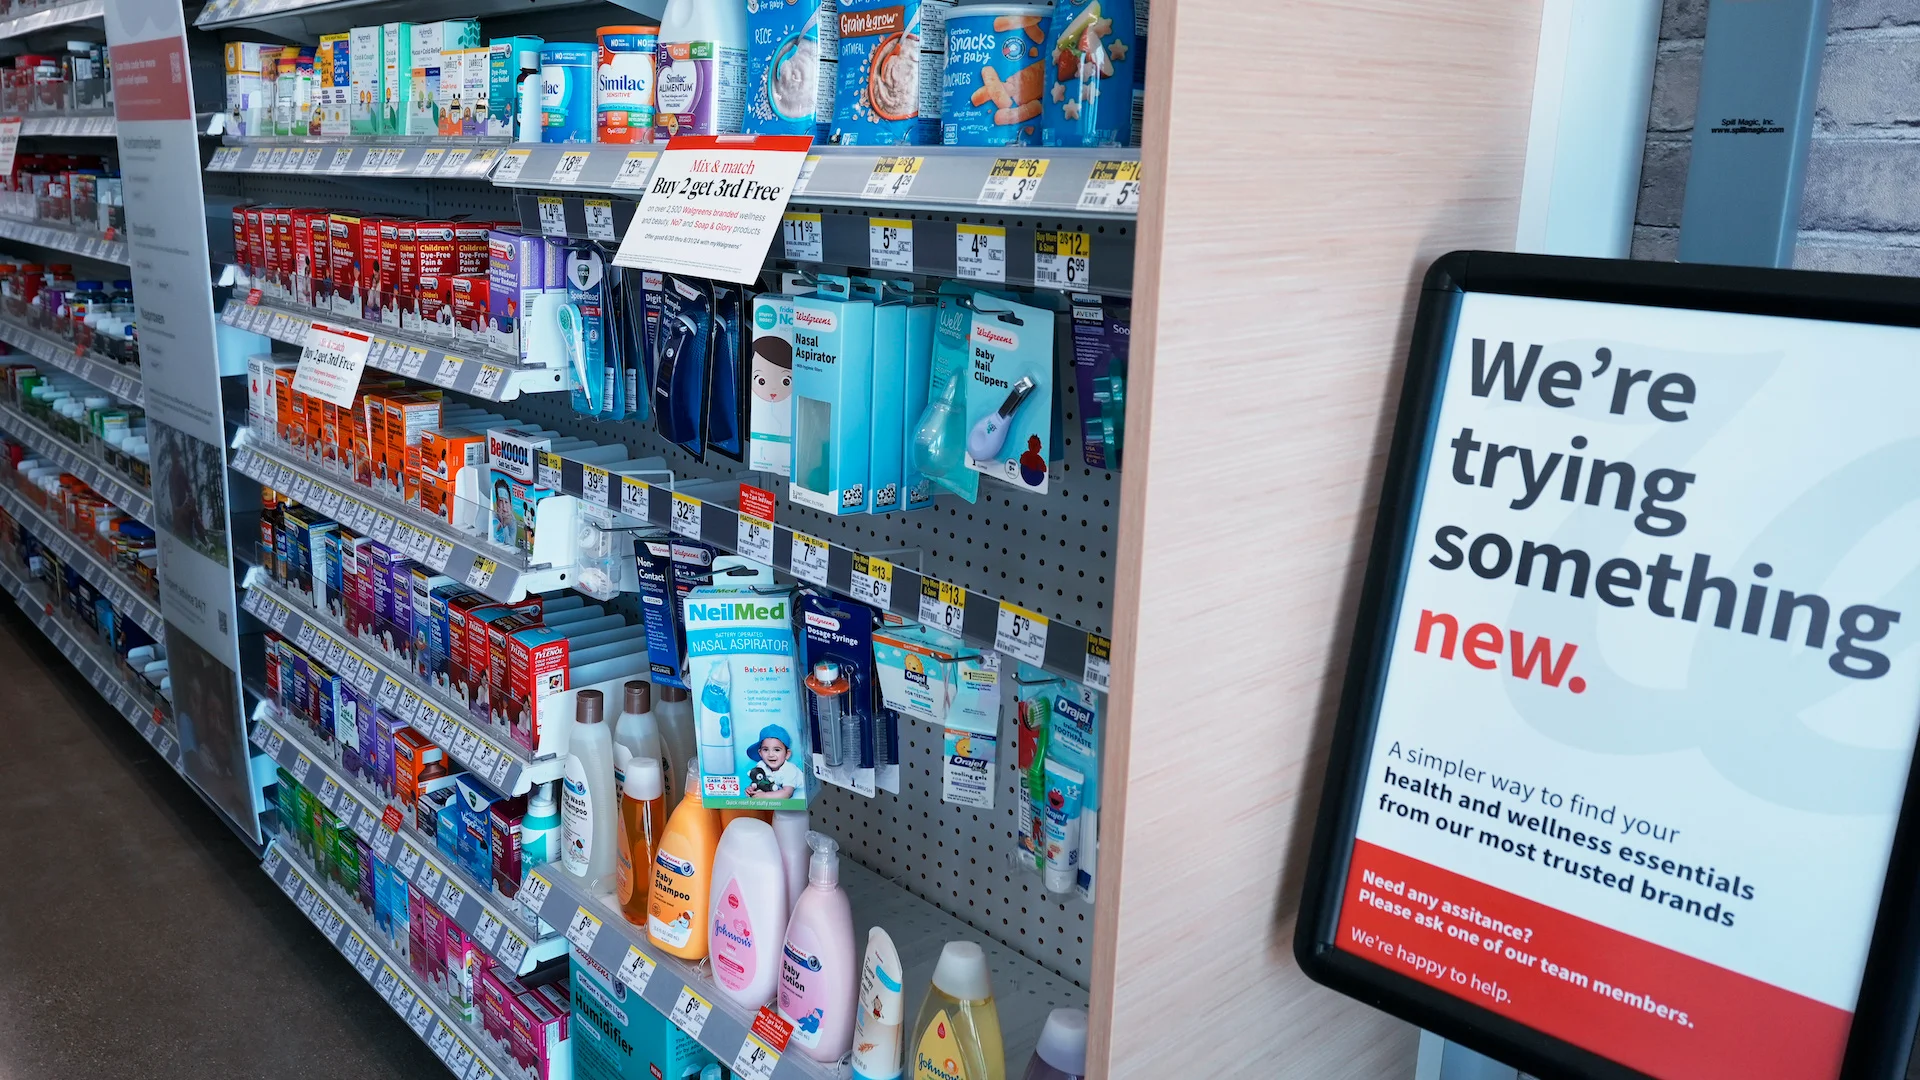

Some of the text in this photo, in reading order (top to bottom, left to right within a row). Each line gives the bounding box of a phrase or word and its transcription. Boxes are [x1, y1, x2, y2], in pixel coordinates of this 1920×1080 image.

[755, 28, 772, 44] RICE
[950, 33, 996, 51] Snacks
[842, 43, 865, 56] OATMEAL
[950, 52, 991, 65] for Baby
[600, 74, 645, 91] Similac
[659, 83, 693, 92] ALIMENTUM
[690, 159, 755, 175] Mix & match
[651, 177, 680, 199] Buy
[679, 178, 691, 195] 2
[687, 180, 715, 200] get
[714, 178, 744, 198] 3rd
[667, 206, 682, 214] 2,500
[682, 206, 712, 217] Walgreens
[713, 207, 739, 218] branded
[740, 212, 766, 222] wellness
[641, 217, 651, 225] and
[671, 218, 682, 226] No7
[682, 220, 694, 228] and
[694, 221, 709, 230] Soap
[710, 222, 715, 230] &
[716, 223, 733, 233] Glory
[733, 225, 761, 235] products
[571, 291, 598, 301] SpeedRead
[796, 312, 831, 326] Walgreens
[940, 308, 963, 331] Well
[1075, 311, 1098, 319] AVENT
[796, 333, 818, 347] Nasal
[976, 327, 1013, 345] Walgreens
[796, 347, 836, 364] Aspirator
[975, 347, 995, 362] Baby
[975, 361, 991, 372] Nail
[974, 371, 1008, 389] Clippers
[1451, 427, 1696, 537] trying
[798, 534, 810, 543] FSA
[637, 556, 654, 567] Non-
[673, 548, 699, 559] Walgreens
[639, 569, 665, 582] Contact
[1428, 524, 1901, 680] something
[689, 602, 785, 622] NeilMed
[807, 615, 836, 627] Walgreens
[807, 626, 858, 646] Dosage Syringe
[535, 648, 563, 661] TYLENOL
[693, 639, 789, 653] NASAL ASPIRATOR
[1414, 609, 1587, 694] new.
[906, 672, 926, 684] Orajel
[1058, 699, 1091, 724] Orajel
[1054, 724, 1092, 748] TOOTHPASTE
[954, 757, 983, 769] Orajel
[951, 771, 987, 781] cooling gels
[1388, 741, 1680, 844] A simpler way to find your
[571, 797, 585, 807] Wash
[1045, 807, 1066, 822] Orajel
[1384, 767, 1755, 901] health and wellness essentials
[1379, 794, 1735, 927] from our most trusted brands
[656, 870, 673, 885] Baby
[655, 882, 690, 901] Shampoo
[1363, 868, 1533, 944] Need any assitance?
[715, 919, 751, 948] Johnson's
[1359, 889, 1694, 1029] Please ask one of our team members.
[783, 959, 800, 979] Baby
[1397, 944, 1446, 980] happy
[1450, 965, 1466, 985] to
[1470, 970, 1511, 1004] help.
[782, 970, 805, 992] Lotion
[575, 991, 634, 1057] Humidifier
